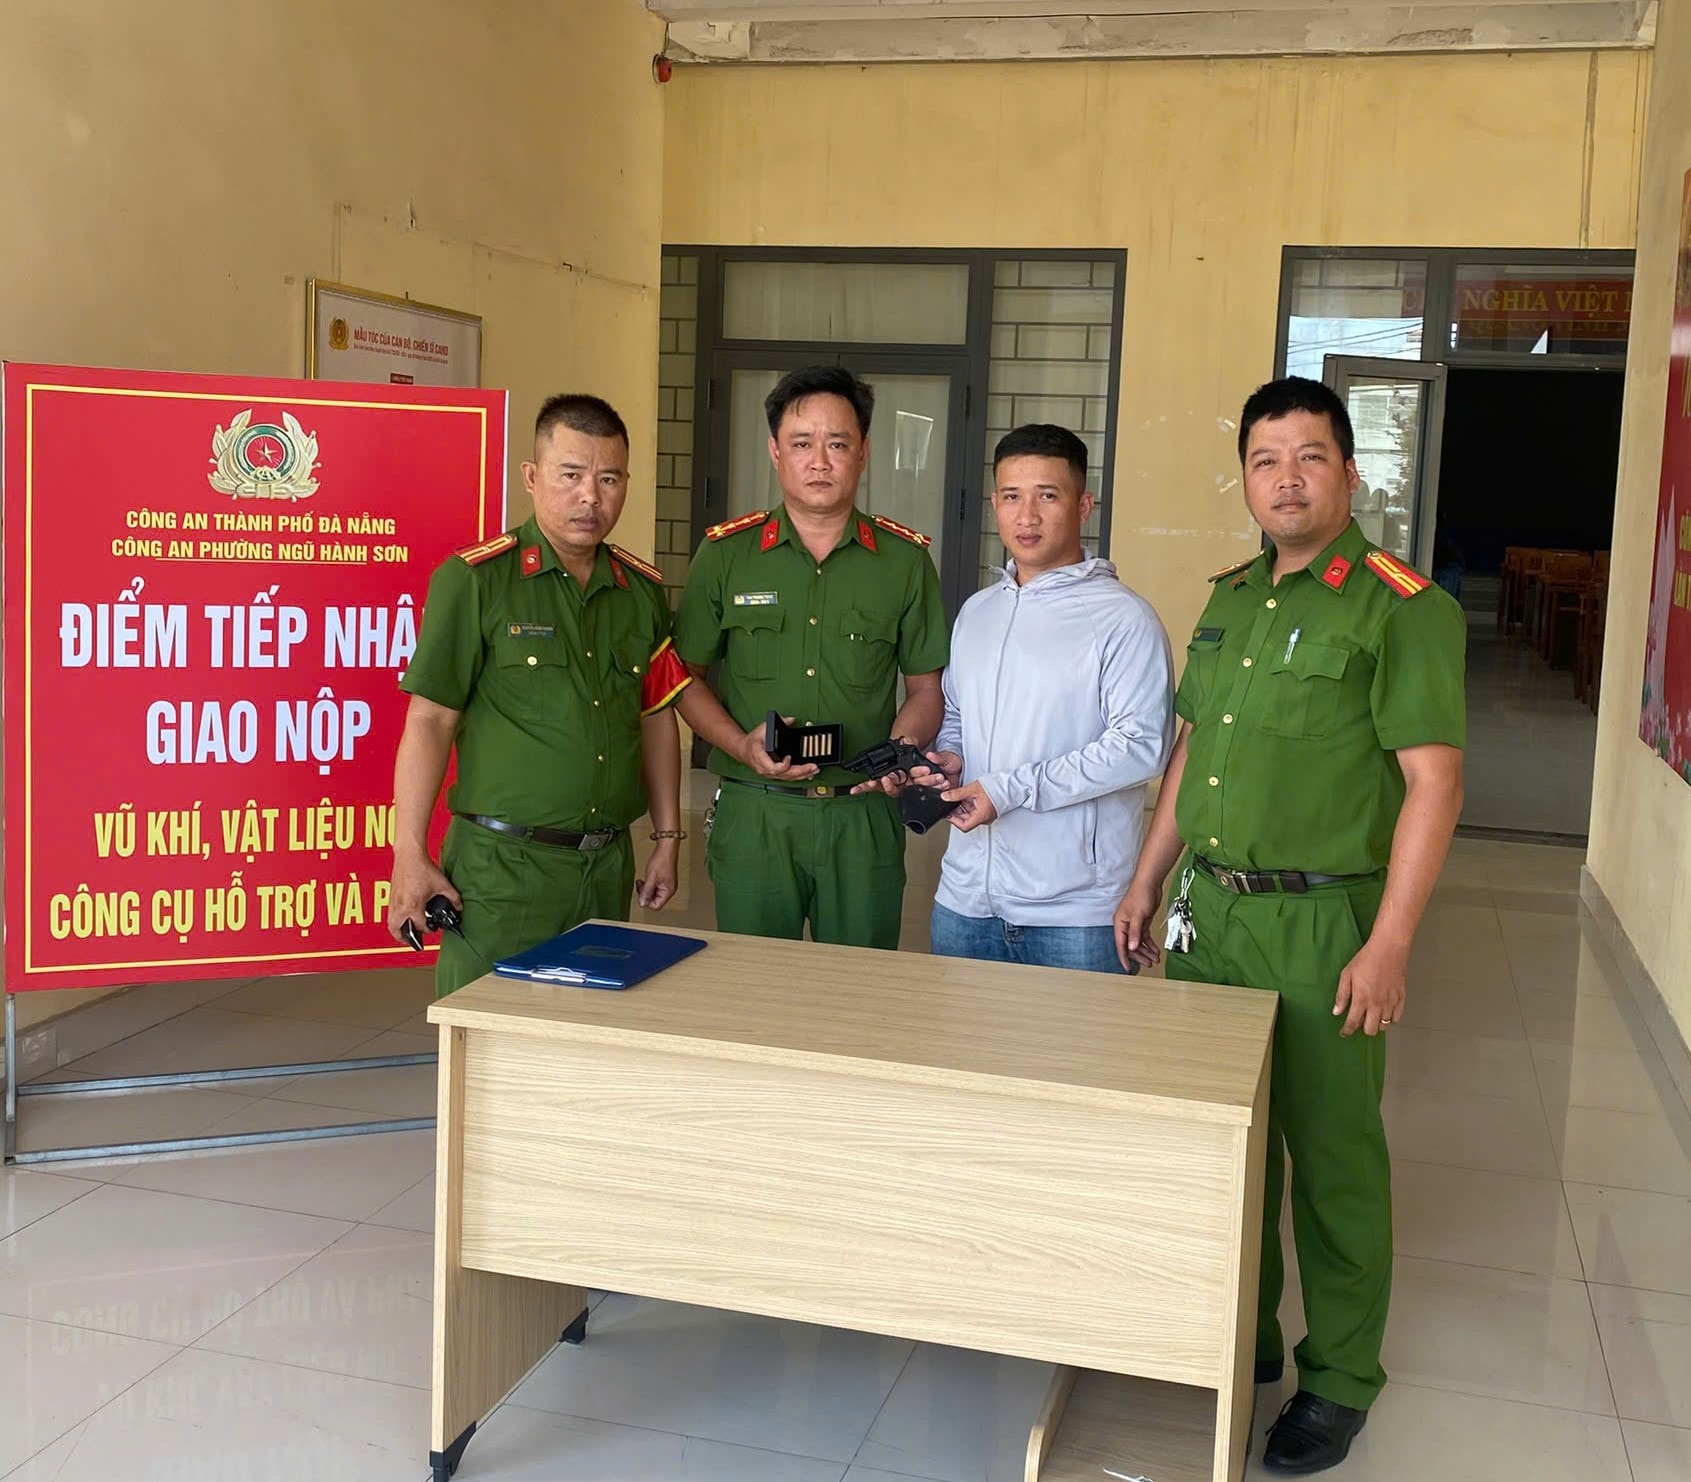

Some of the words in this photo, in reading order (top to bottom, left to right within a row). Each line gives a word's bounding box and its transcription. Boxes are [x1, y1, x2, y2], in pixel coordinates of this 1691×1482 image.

[1463, 284, 1548, 313] NGHĨA
[1555, 284, 1618, 319] VIỆT
[111, 536, 162, 557] CÔNG
[168, 540, 193, 558] AN
[199, 538, 273, 560] PHƯỜNG
[278, 540, 315, 561] NGŨ
[320, 540, 367, 562] HÀNH
[372, 546, 408, 562] SƠN
[126, 508, 177, 529] CÔNG
[183, 513, 208, 530] AN
[213, 512, 272, 532] THÀNH
[278, 510, 314, 533] PHỐ
[318, 513, 342, 534] ĐÀ
[347, 511, 396, 535] NẴNG
[59, 576, 187, 668] ĐIỂM
[204, 585, 308, 668] TIẾP
[325, 593, 424, 682] NHẬ
[145, 700, 258, 765] GIAO
[275, 687, 371, 776] NỘP
[94, 803, 136, 858] VŨ
[147, 800, 210, 861] KHÍ,
[221, 800, 279, 864] VẬT
[289, 798, 354, 860] LIỆU
[49, 883, 140, 938] CÔNG
[151, 889, 195, 944] CỤ
[205, 871, 246, 934] HỖ
[256, 880, 317, 938] TRỢ
[326, 873, 364, 925] VÀ
